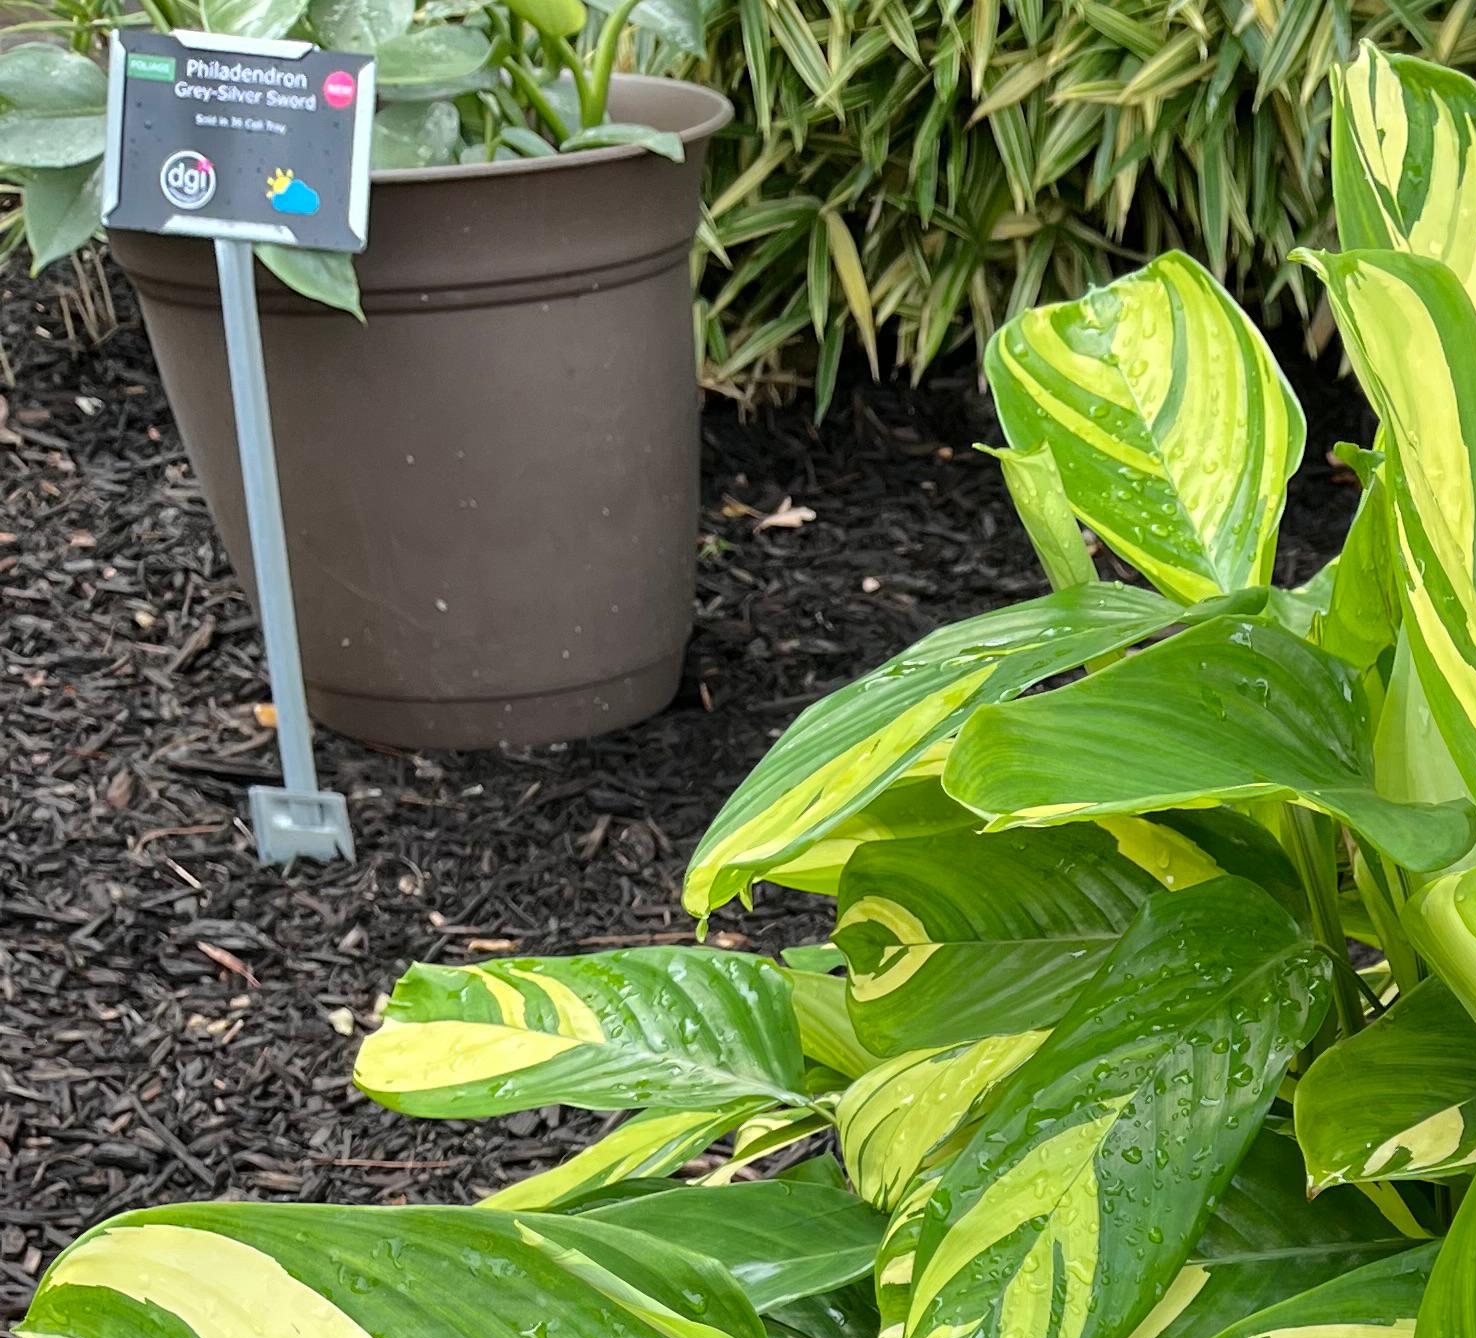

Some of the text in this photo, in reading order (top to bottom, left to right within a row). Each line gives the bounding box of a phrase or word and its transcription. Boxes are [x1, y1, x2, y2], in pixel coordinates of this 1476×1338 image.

[186, 59, 308, 88] Philadendron
[174, 81, 317, 112] Grey-Silver Sword
[195, 113, 217, 128] Sold
[219, 116, 229, 128] in
[266, 120, 287, 135] Tray
[167, 162, 207, 194] dgi
